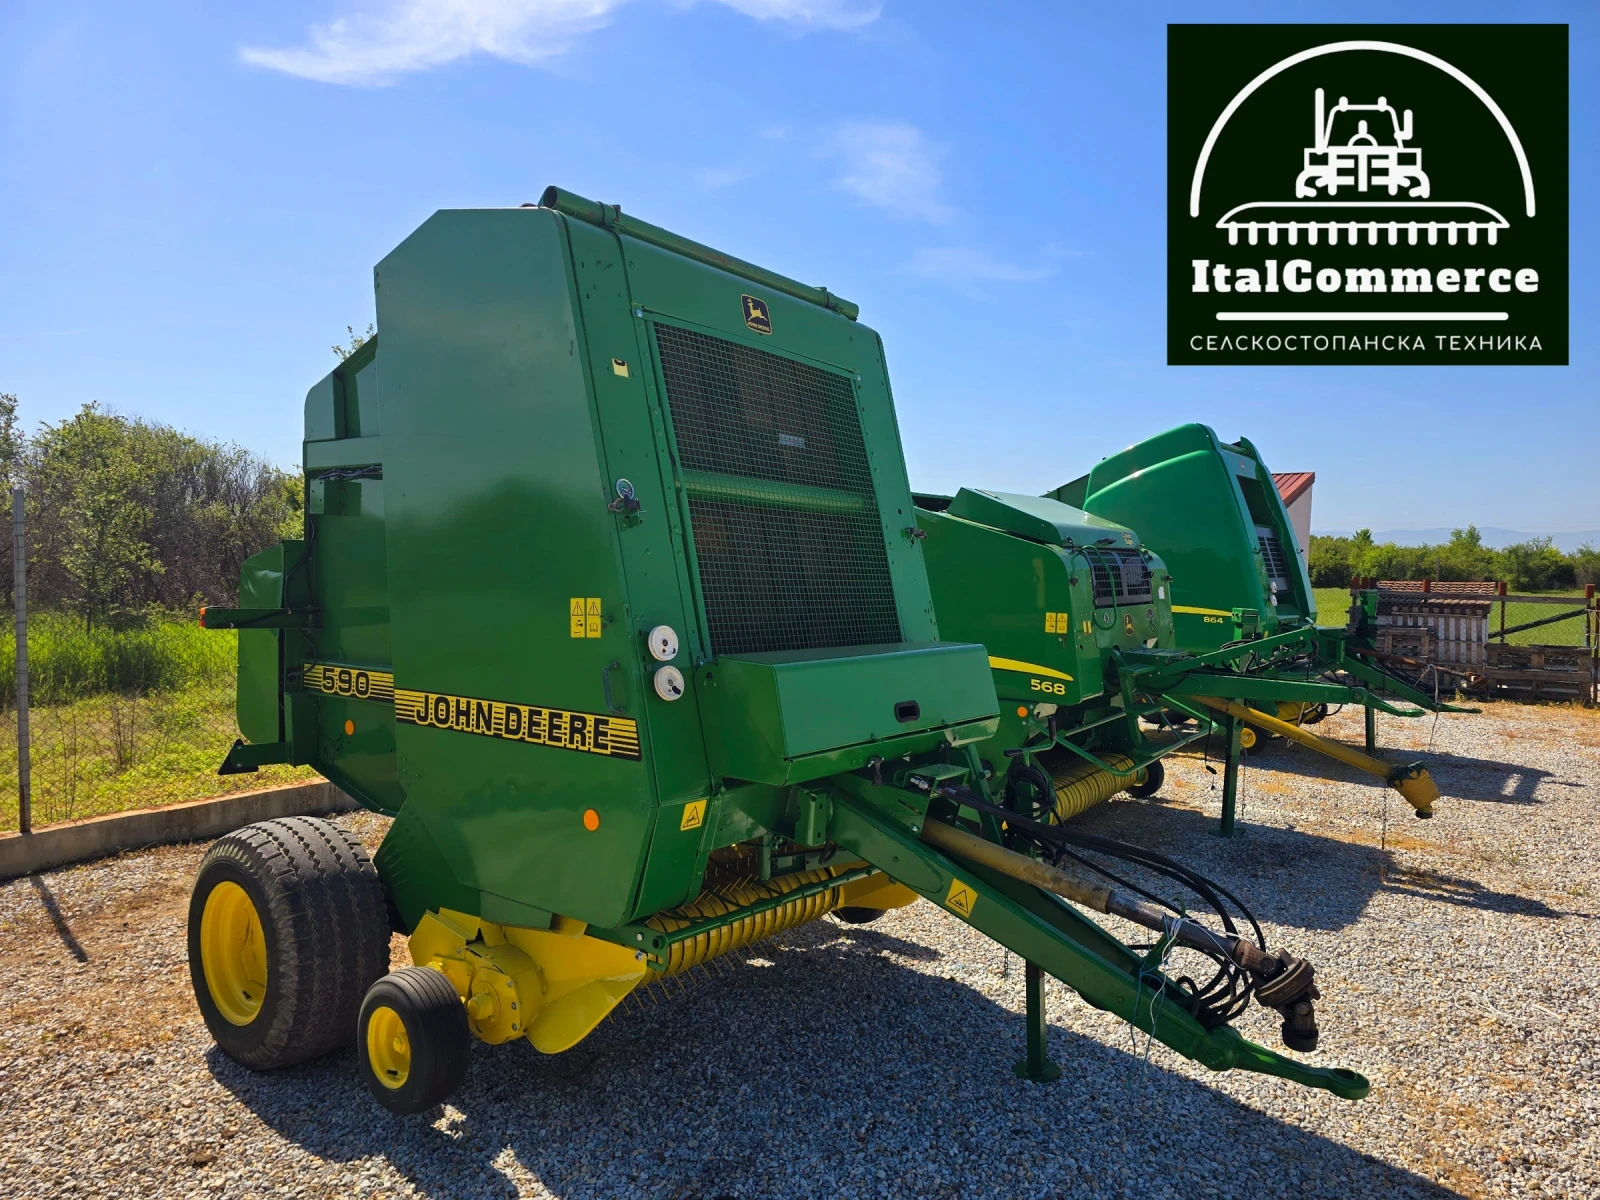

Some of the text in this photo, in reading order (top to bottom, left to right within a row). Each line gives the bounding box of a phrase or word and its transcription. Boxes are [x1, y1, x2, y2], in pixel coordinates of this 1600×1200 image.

[1203, 616, 1224, 624] 864
[321, 666, 370, 698] 590
[1030, 678, 1066, 695] 568
[415, 694, 611, 754] JOHN DEERE
